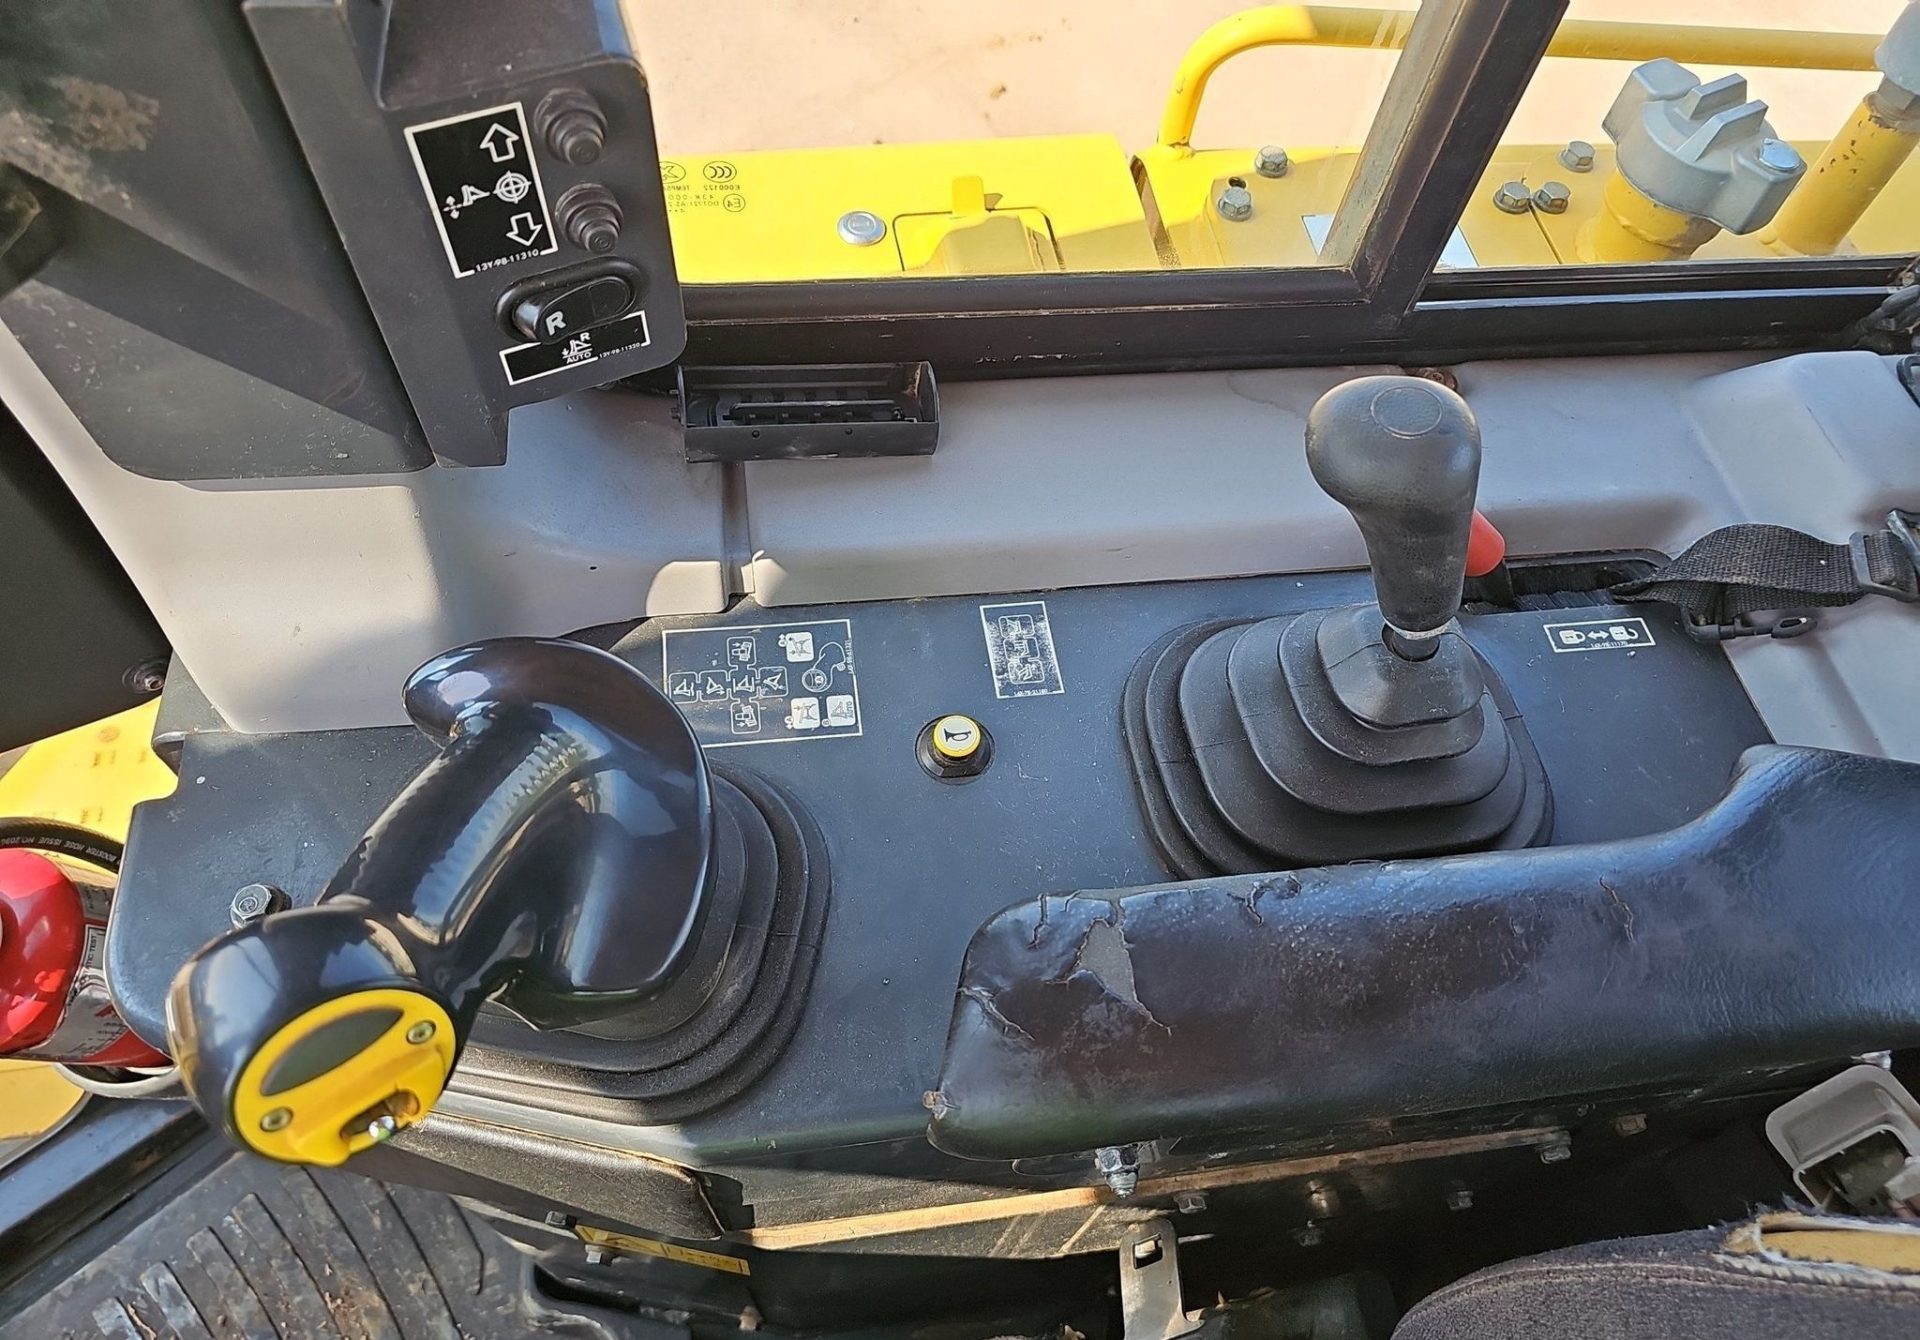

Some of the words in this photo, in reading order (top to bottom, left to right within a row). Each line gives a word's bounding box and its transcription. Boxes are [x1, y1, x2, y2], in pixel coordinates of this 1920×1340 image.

[546, 311, 567, 336] R
[579, 332, 591, 342] R
[566, 352, 592, 364] AUTO
[846, 701, 854, 719] AUTO
[63, 840, 86, 851] HOSE
